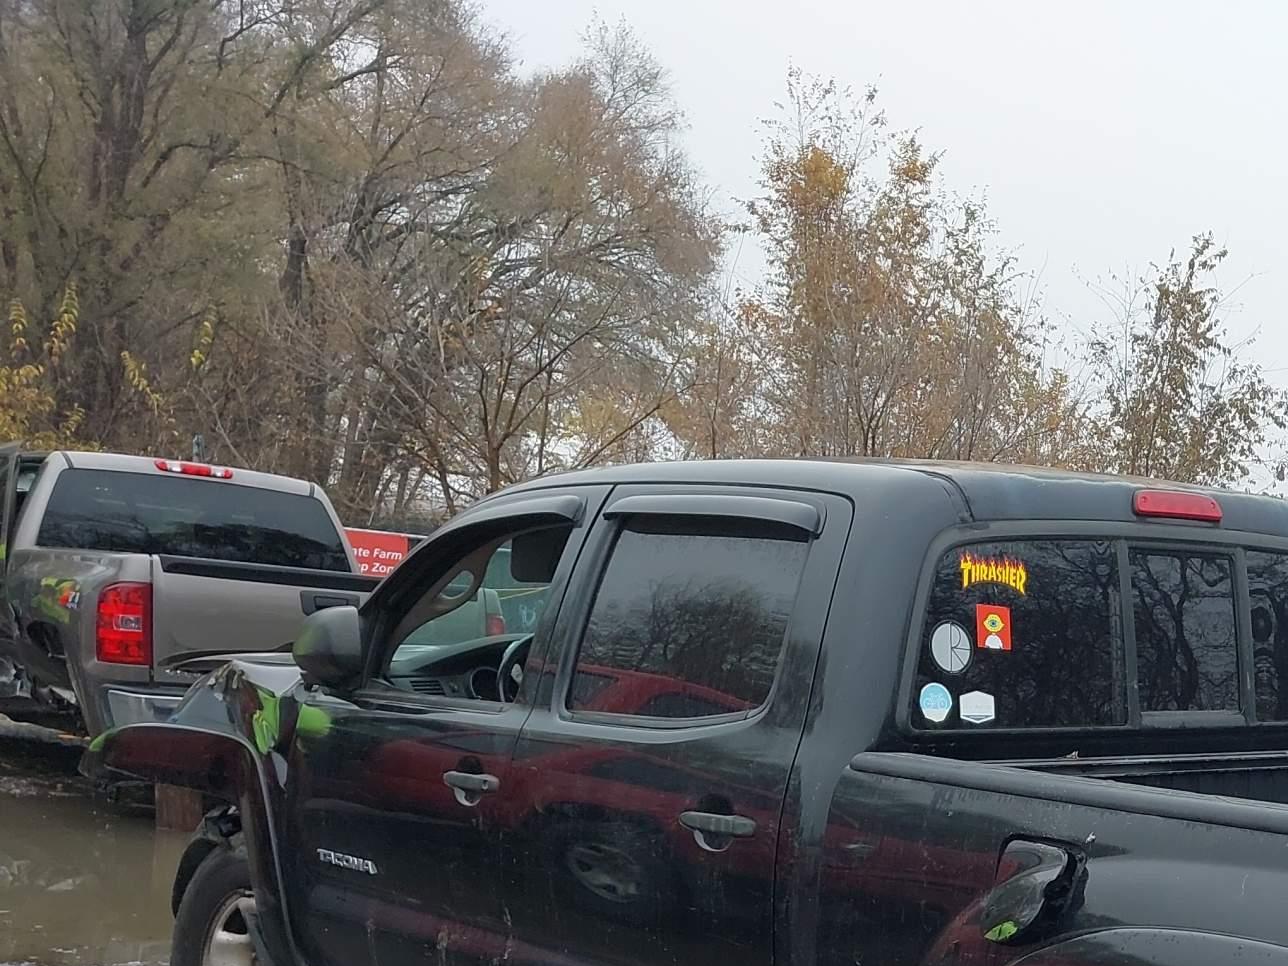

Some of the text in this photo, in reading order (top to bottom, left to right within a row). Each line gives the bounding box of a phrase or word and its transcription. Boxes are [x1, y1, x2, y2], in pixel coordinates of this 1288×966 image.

[373, 548, 402, 560] Farm
[960, 554, 1026, 594] THRASHER
[317, 848, 378, 875] TACOMA
